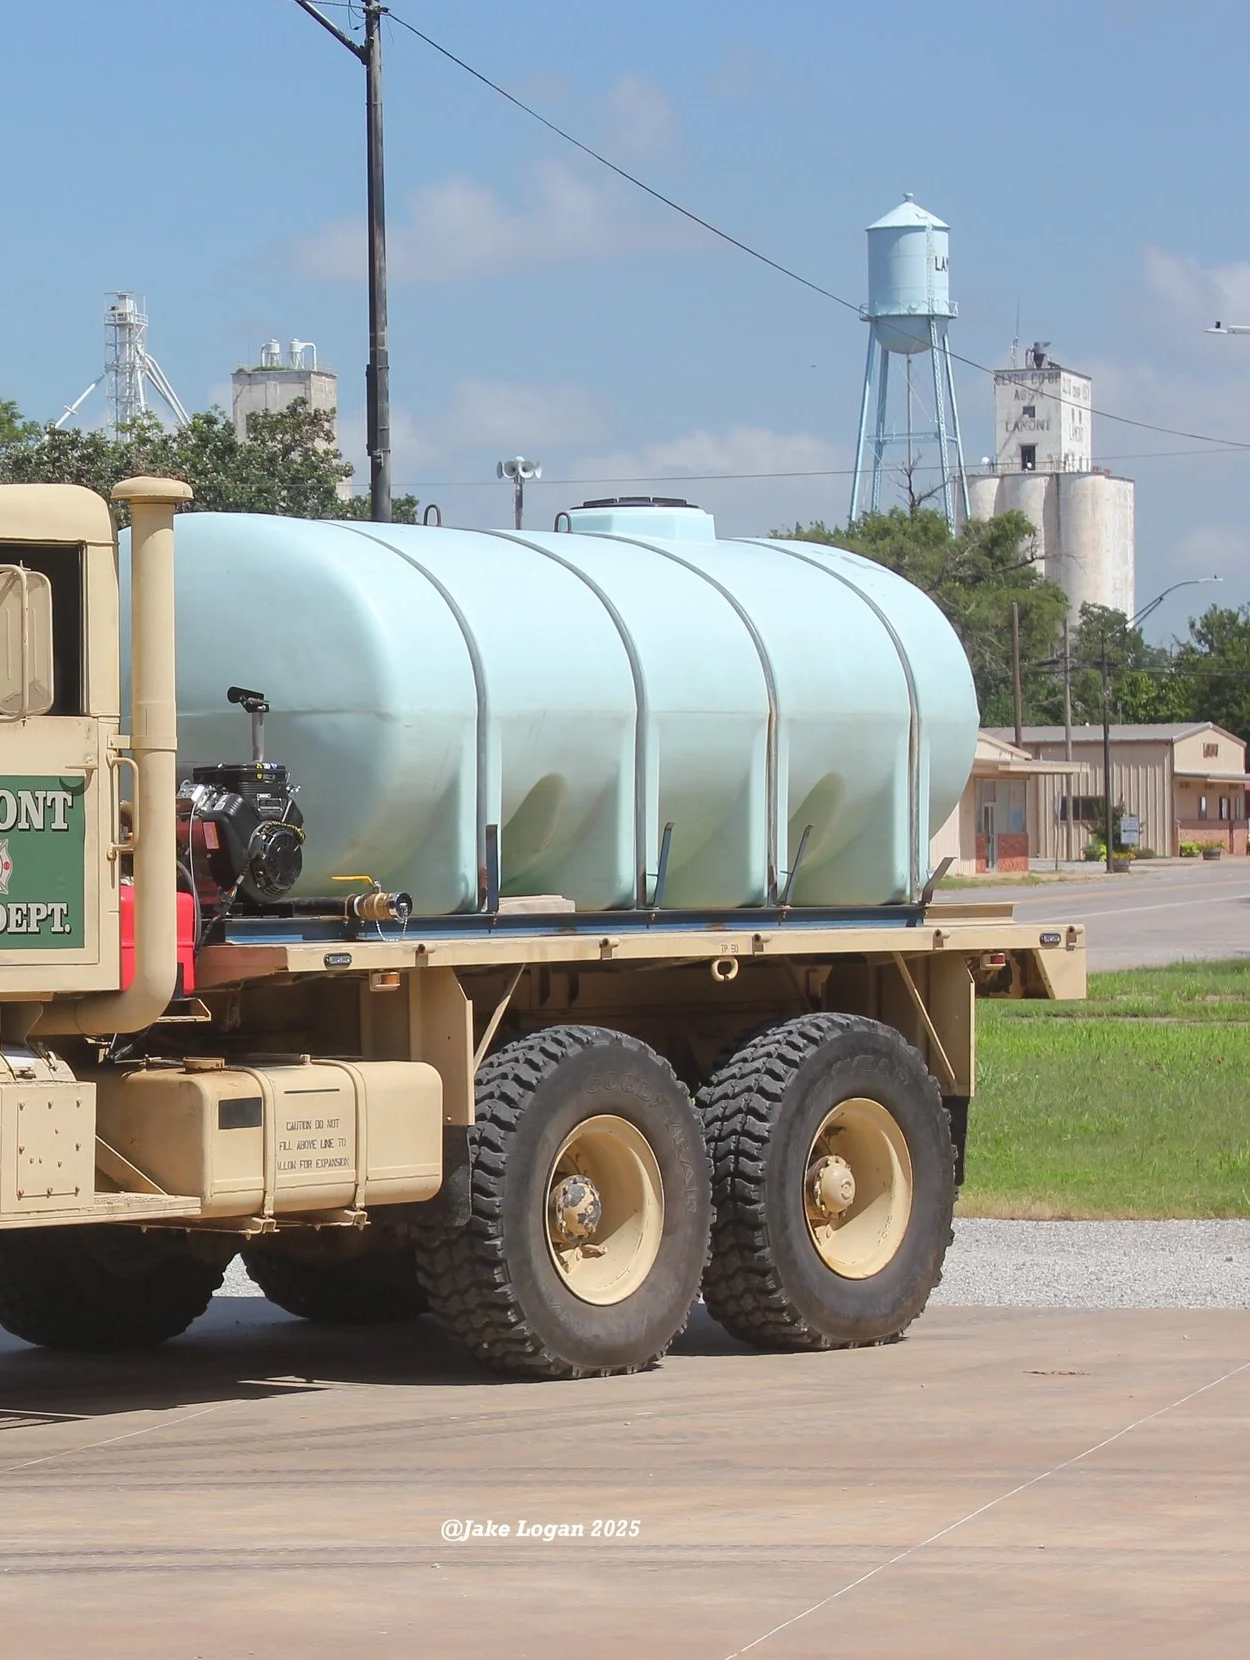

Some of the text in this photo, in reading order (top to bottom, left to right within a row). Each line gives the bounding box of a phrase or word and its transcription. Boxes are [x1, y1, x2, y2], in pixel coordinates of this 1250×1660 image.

[1005, 420, 1051, 432] LAMONT
[286, 1118, 340, 1132] CAUTION DO NOT
[279, 1137, 347, 1151] FILL ABOVE LINE TO
[300, 1159, 312, 1169] FOR
[315, 1157, 350, 1169] EXPANSION
